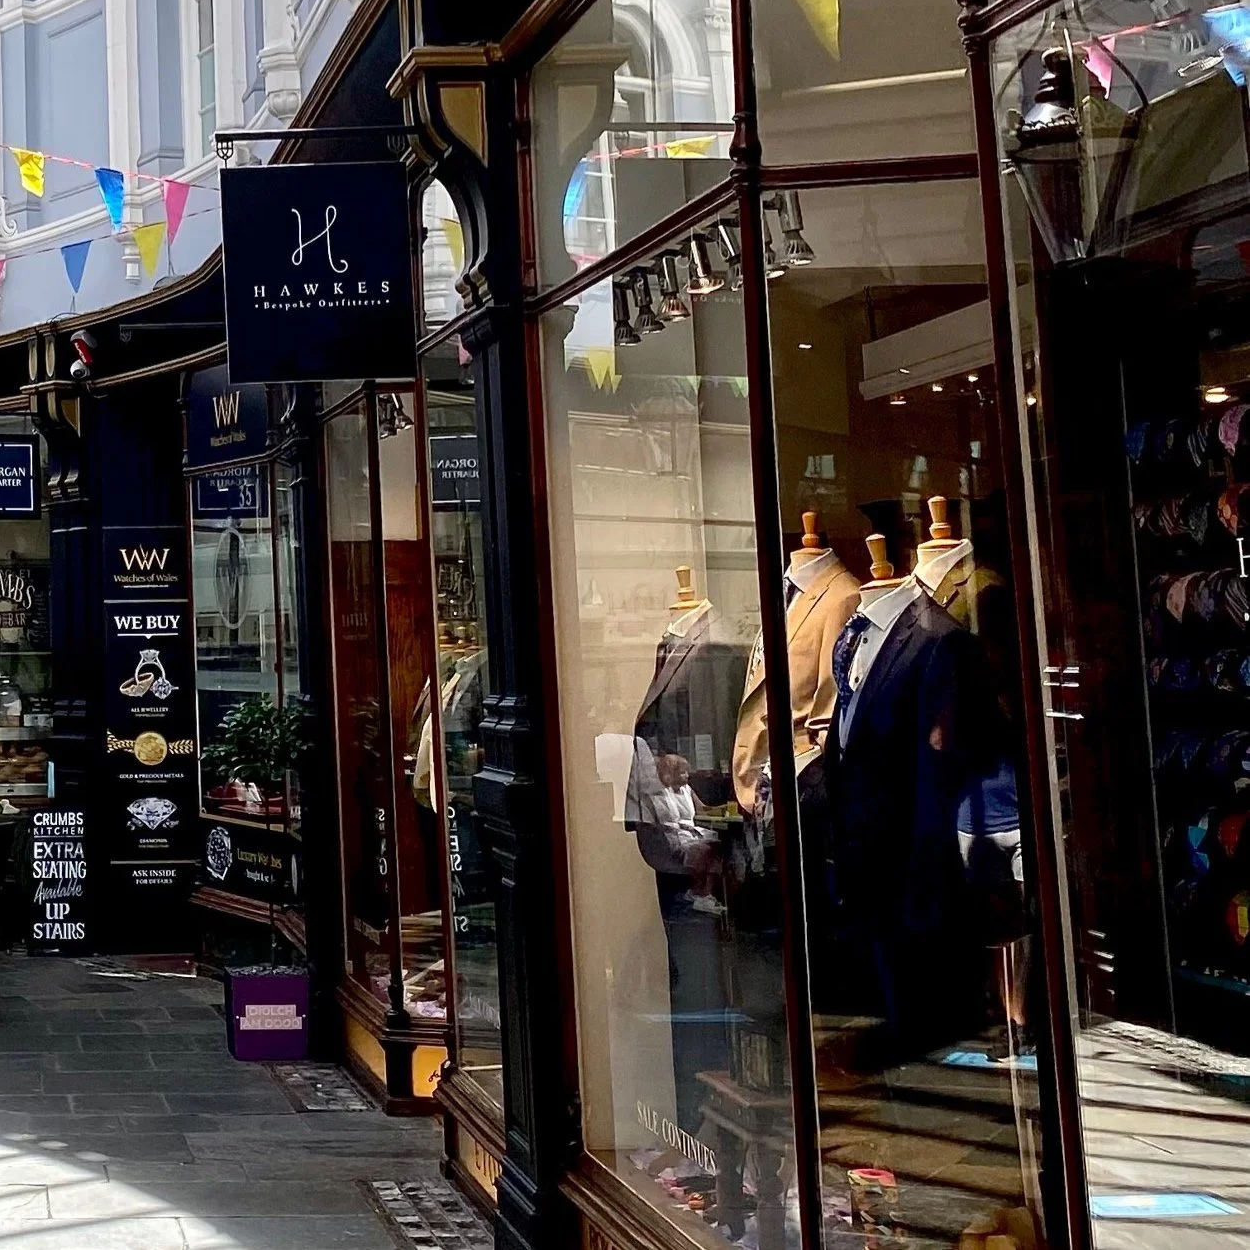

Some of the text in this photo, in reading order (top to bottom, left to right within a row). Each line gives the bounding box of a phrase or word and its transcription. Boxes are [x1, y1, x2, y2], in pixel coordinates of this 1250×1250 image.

[291, 205, 348, 274] H
[253, 281, 390, 298] HAWKES
[263, 298, 381, 311] Bespoke Outfitters
[113, 573, 179, 583] Watches of Wales
[8, 613, 26, 626] BAR
[114, 615, 180, 630] WE BUY
[33, 812, 84, 826] CRUMBS
[33, 827, 84, 835] KITCHEN
[33, 842, 84, 859] EXTRA
[257, 852, 283, 869] Wahes
[33, 860, 87, 879] SEATING
[149, 869, 177, 877] INSIDE
[33, 878, 83, 905] Available
[45, 903, 71, 920] UP
[33, 922, 85, 940] STAIRS
[248, 1006, 295, 1016] DIOLCH
[636, 1100, 718, 1177] SALE CONTINUES
